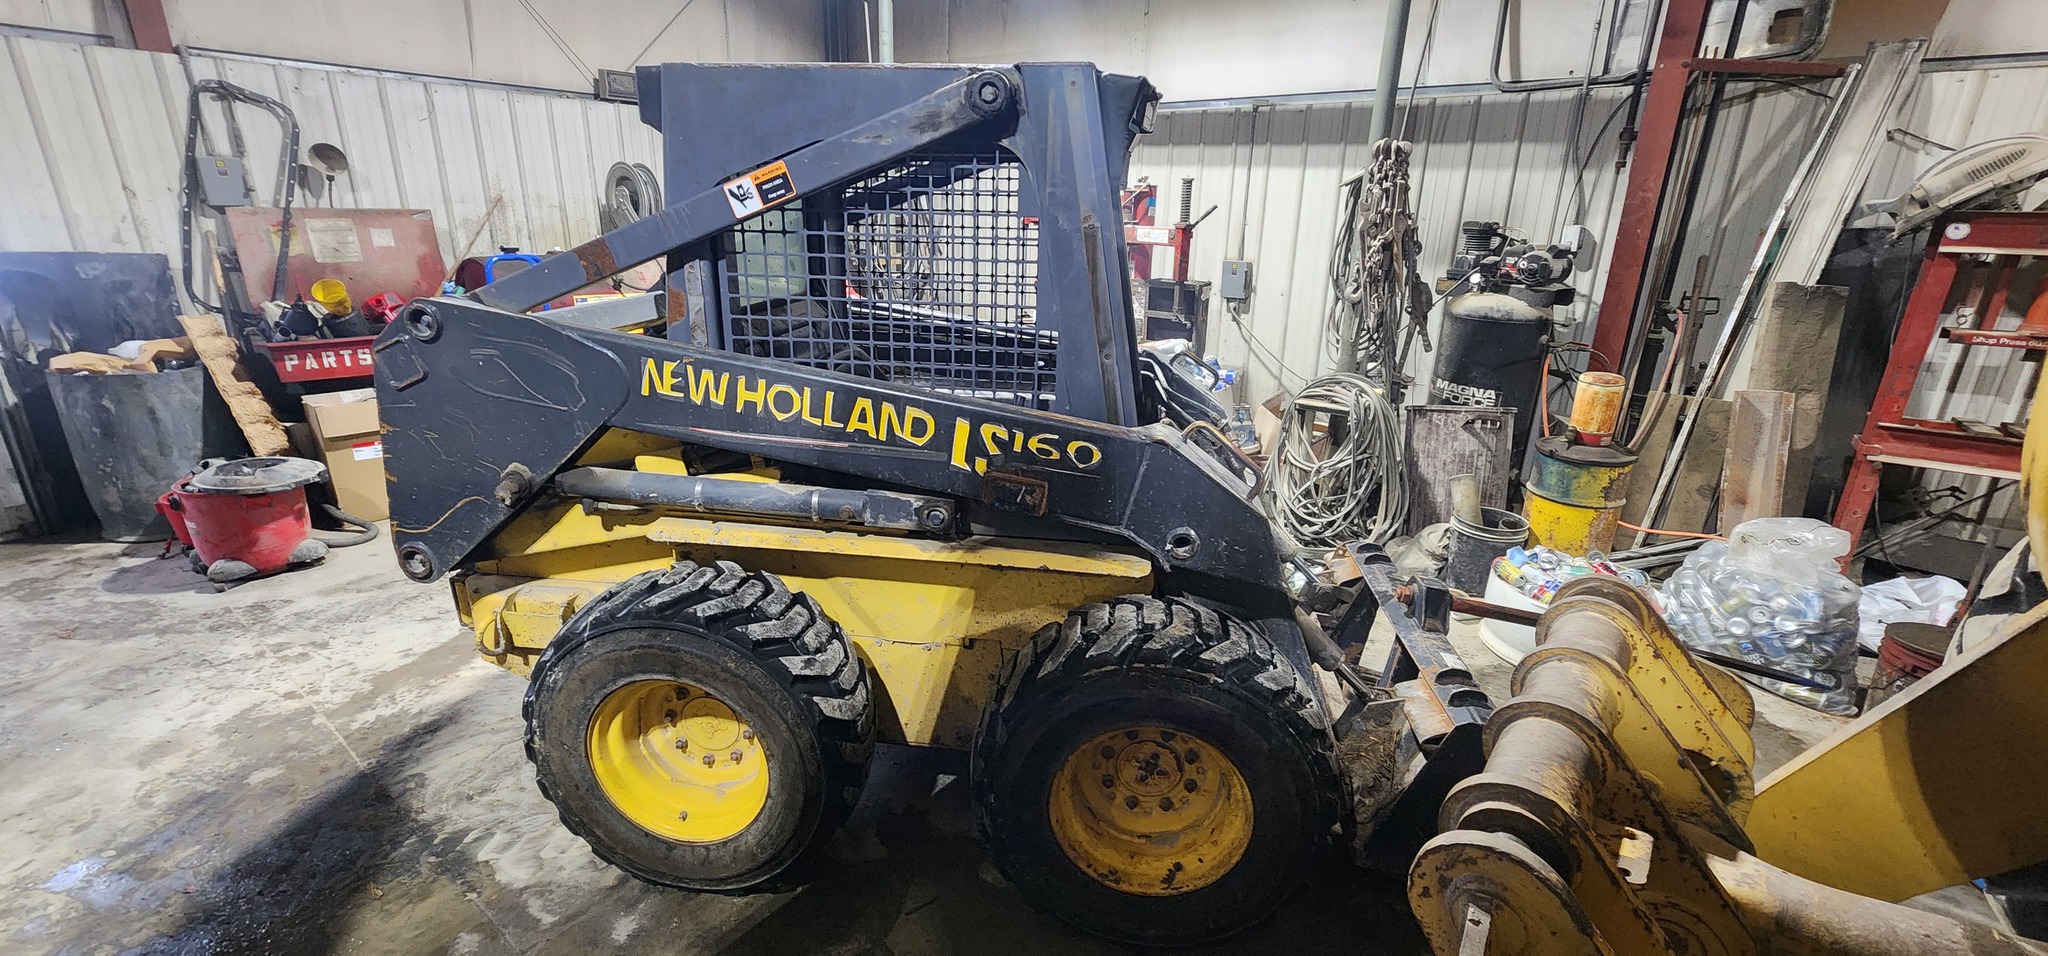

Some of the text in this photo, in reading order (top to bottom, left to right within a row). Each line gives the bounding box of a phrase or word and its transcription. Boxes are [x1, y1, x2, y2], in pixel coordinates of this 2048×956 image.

[761, 166, 783, 177] WARNING
[1972, 335, 1998, 345] Shop
[1999, 337, 2027, 346] Press
[284, 348, 373, 371] PARTS
[1436, 378, 1497, 399] MAGNA
[640, 357, 936, 447] NEW HOLLAND
[1442, 390, 1496, 408] FORCE
